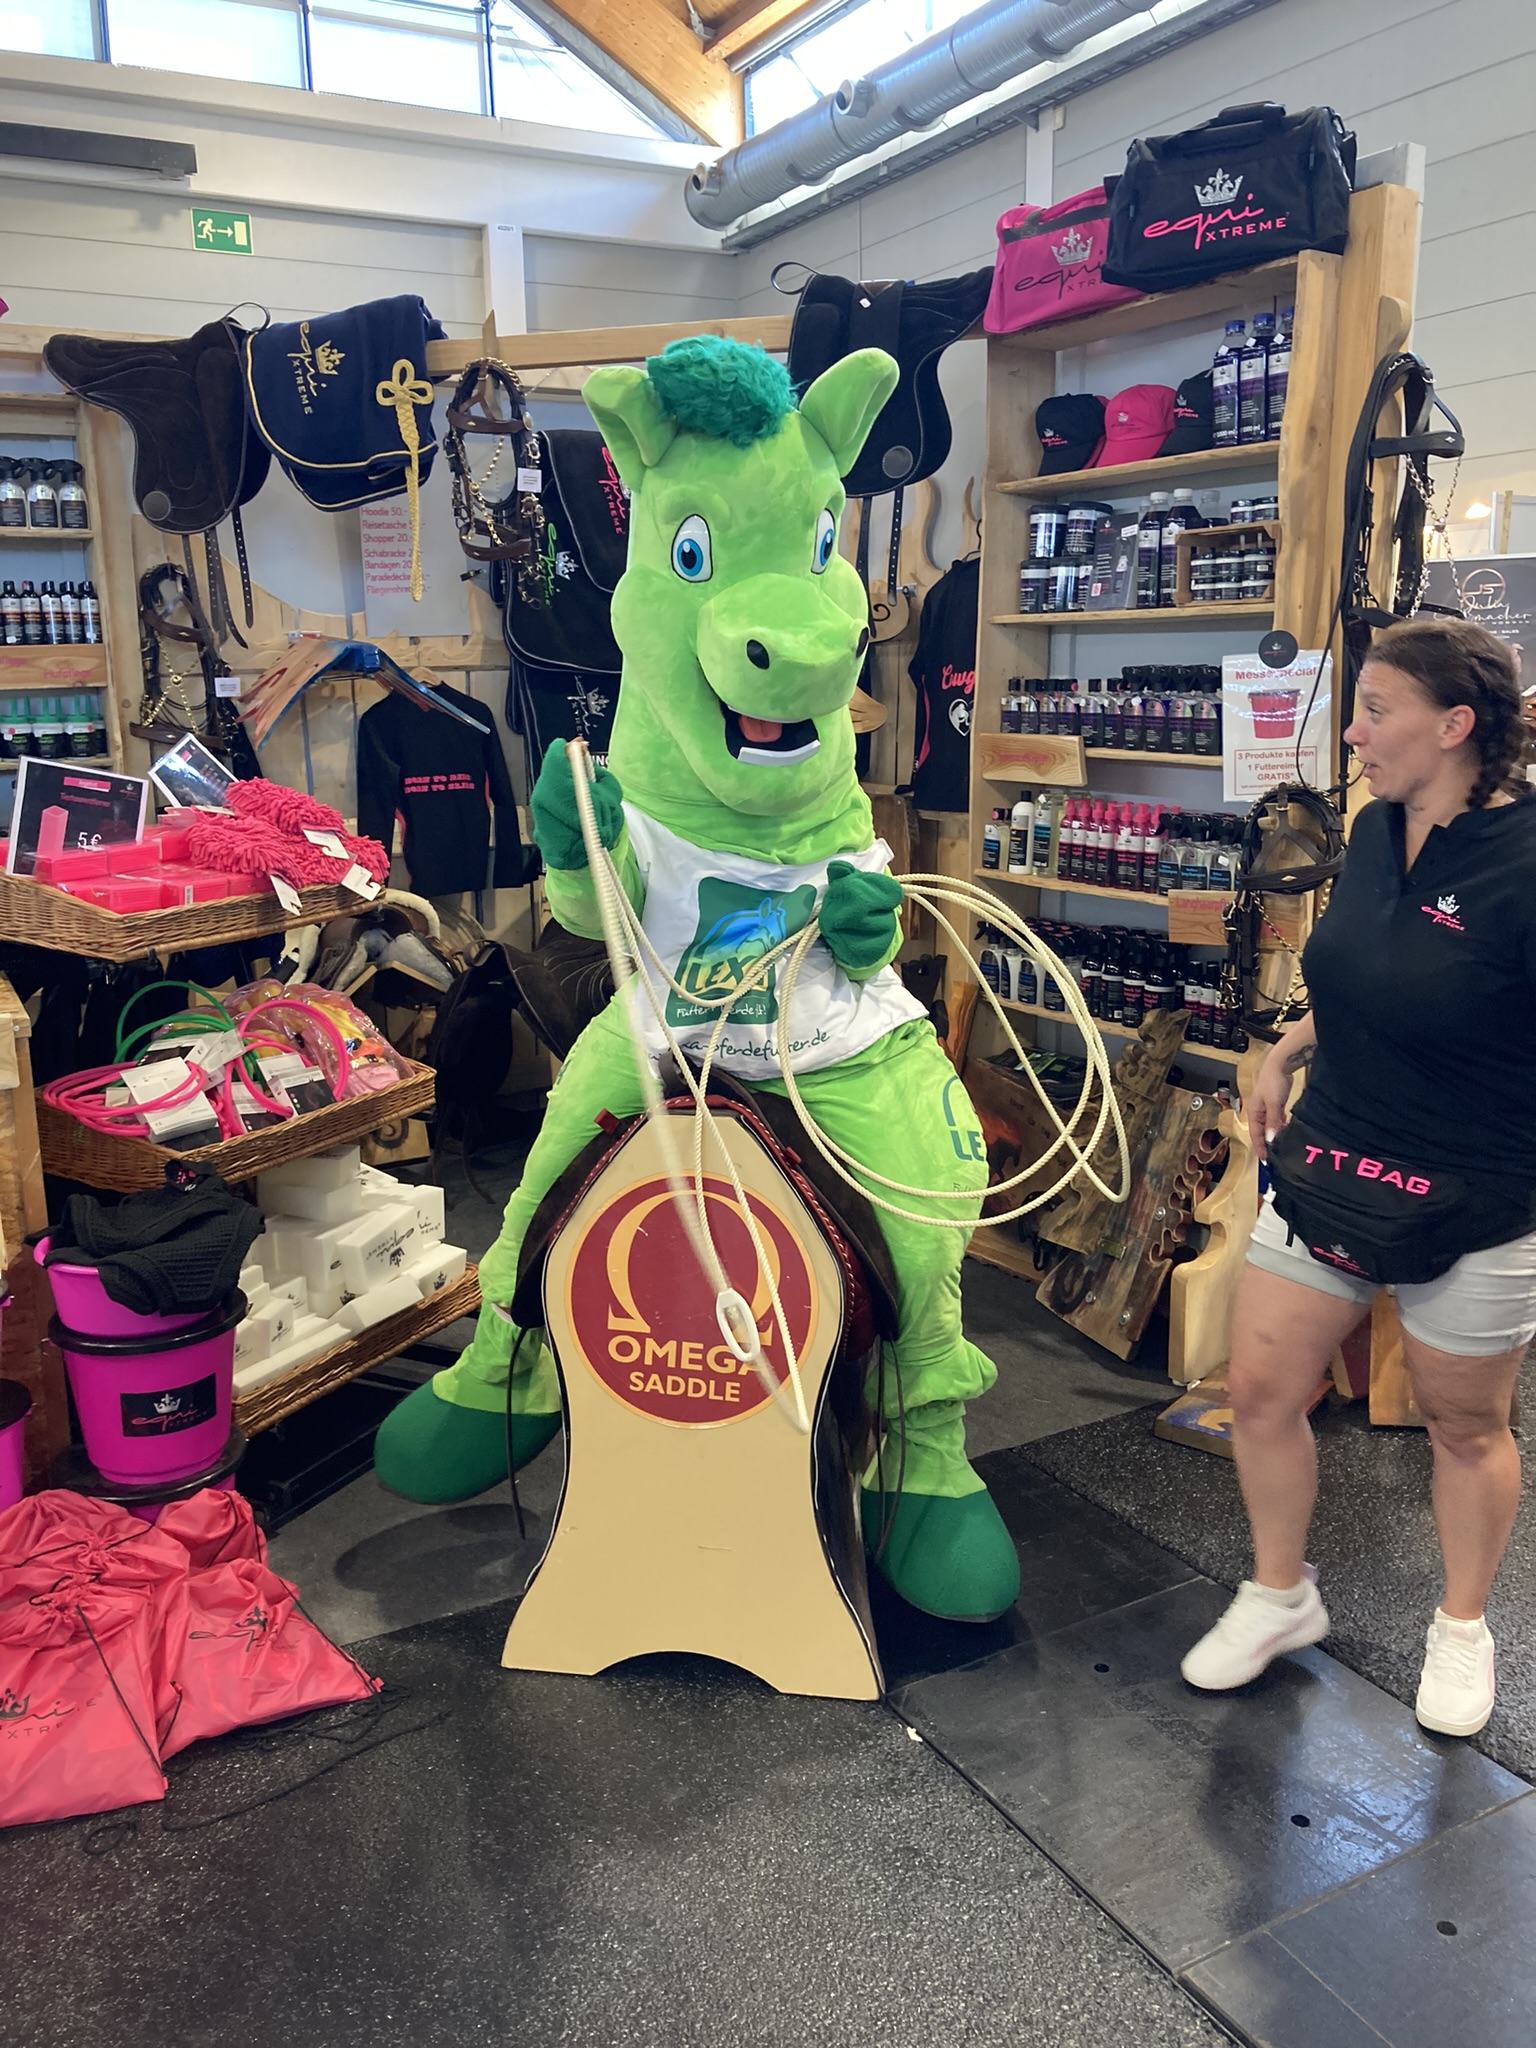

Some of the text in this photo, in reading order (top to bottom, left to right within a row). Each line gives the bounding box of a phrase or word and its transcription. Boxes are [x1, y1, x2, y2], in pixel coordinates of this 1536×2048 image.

[1143, 192, 1264, 250] equi
[1205, 217, 1287, 242] XTREME
[1067, 279, 1103, 292] XTR
[287, 321, 327, 397] equi
[292, 358, 314, 415] XTREME
[361, 507, 389, 517] Hoodie
[603, 486, 623, 534] XTREME
[362, 520, 407, 529] Reisetasche
[363, 534, 395, 544] Shopper
[364, 549, 406, 558] Schabracke
[364, 560, 400, 571] Bandagen
[1237, 750, 1314, 760] 3 Produkte kafen
[1356, 1157, 1431, 1195] BAG
[629, 1371, 741, 1402] SADDLE
